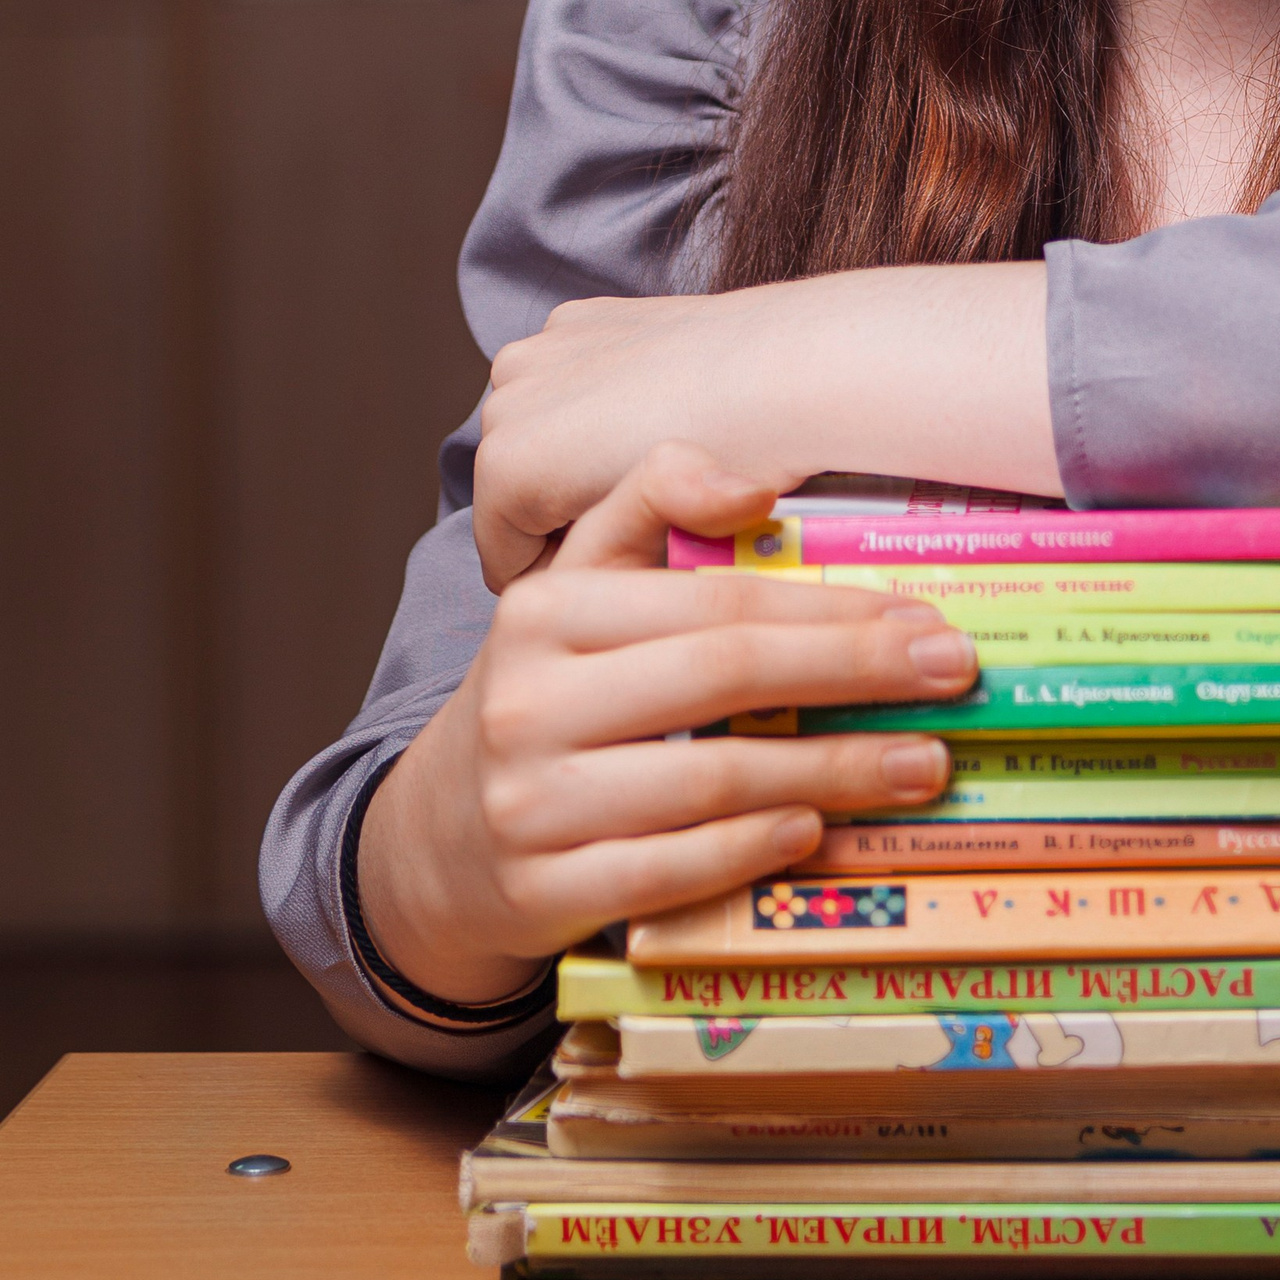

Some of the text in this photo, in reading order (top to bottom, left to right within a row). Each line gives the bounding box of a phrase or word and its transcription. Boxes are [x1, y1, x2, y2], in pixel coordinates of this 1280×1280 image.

[860, 531, 1023, 555] Литературное
[1031, 530, 1113, 548] чтение
[887, 579, 1044, 598] Литературное
[1055, 580, 1135, 593] чтение
[662, 965, 1255, 1007] РАСТЁМ, ИГРАЕМ, УЗНАЁМ
[560, 1215, 1145, 1251] РАСТЁМ, ИГРАЕМ, УЗНАЁМ
